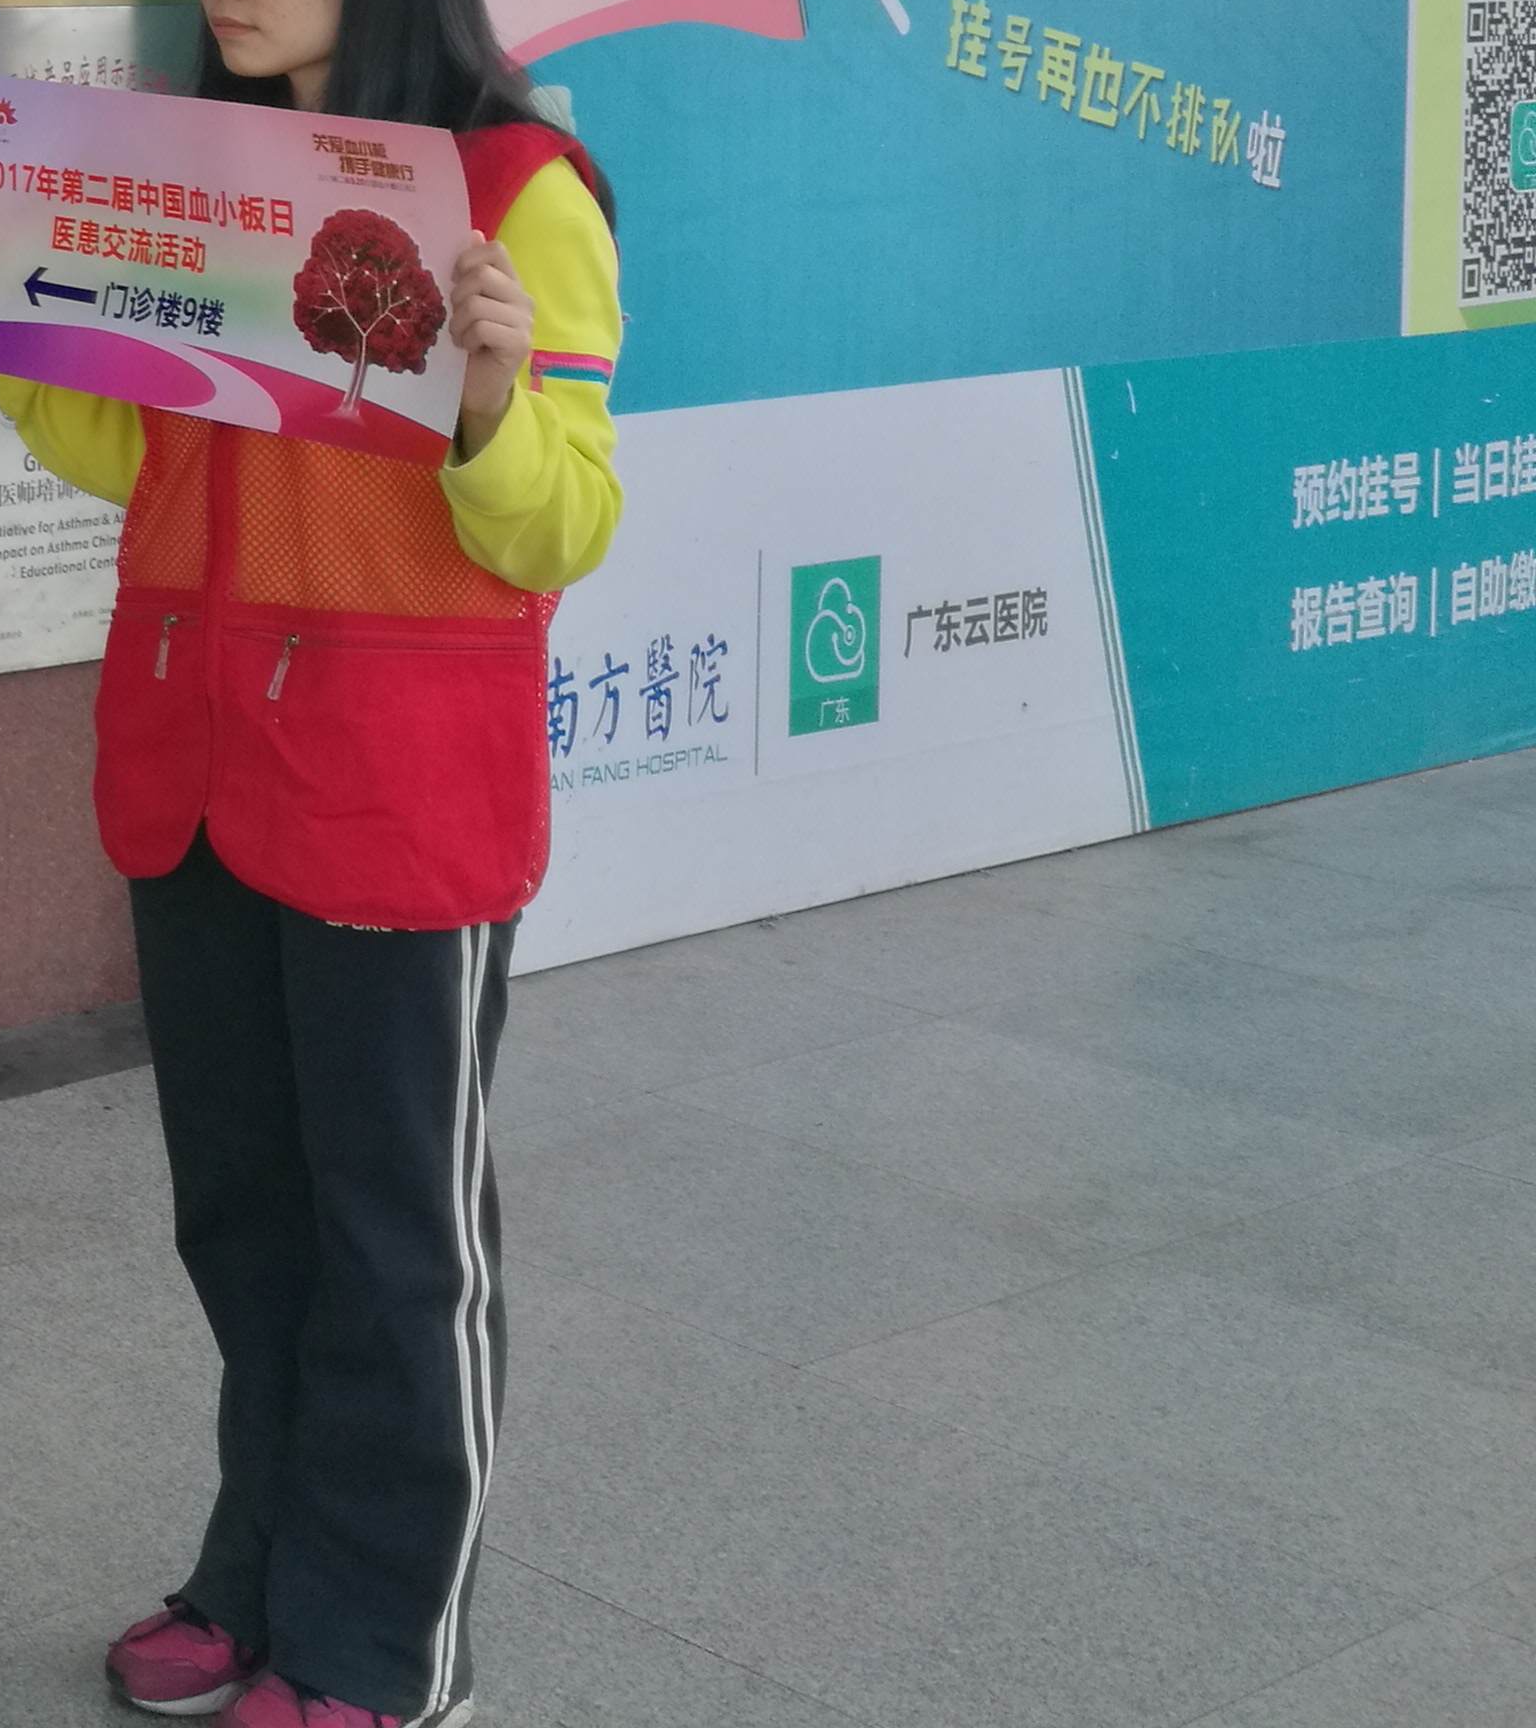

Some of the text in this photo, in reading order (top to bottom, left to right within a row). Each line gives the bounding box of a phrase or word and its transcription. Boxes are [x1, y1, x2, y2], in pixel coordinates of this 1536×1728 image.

[51, 215, 207, 274] 医患交流活动
[101, 282, 225, 338] 门诊楼9楼
[1291, 451, 1423, 530] 预约挂号
[30, 545, 45, 557] on
[47, 538, 90, 555] Asthma
[57, 515, 101, 532] Asthma
[19, 559, 88, 580] Educational
[903, 587, 1050, 661] 广东云医院
[1290, 571, 1419, 653] 报告查询
[817, 696, 851, 727] 广东
[581, 759, 631, 787] FANG
[636, 744, 729, 778] HOSPITAL
